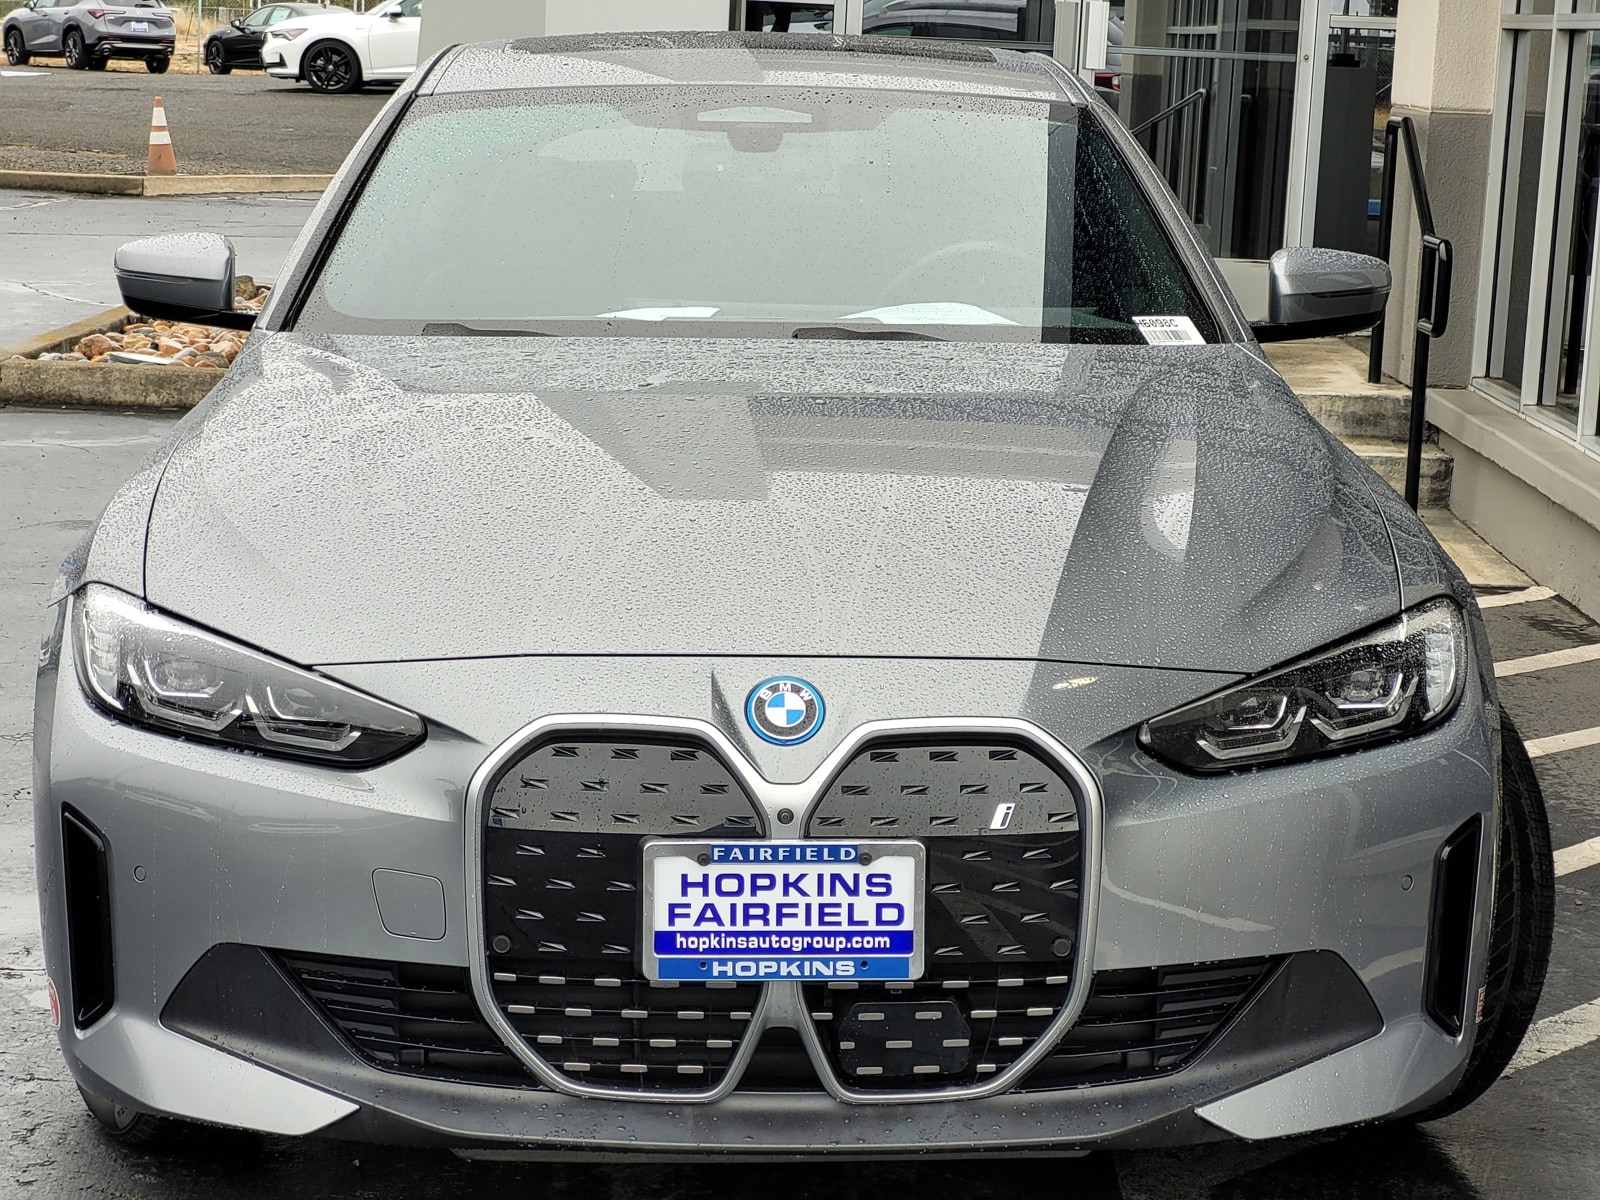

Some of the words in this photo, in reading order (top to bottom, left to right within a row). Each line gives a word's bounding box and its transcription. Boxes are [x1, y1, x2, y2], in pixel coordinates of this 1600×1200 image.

[760, 683, 813, 700] BMW
[713, 847, 857, 861] FAIRFIELD
[680, 873, 893, 897] HOPKINS
[668, 903, 905, 927] FAIRFIELD
[676, 933, 890, 952] hopkinsautogroup.com
[713, 961, 856, 976] HOPKINS
